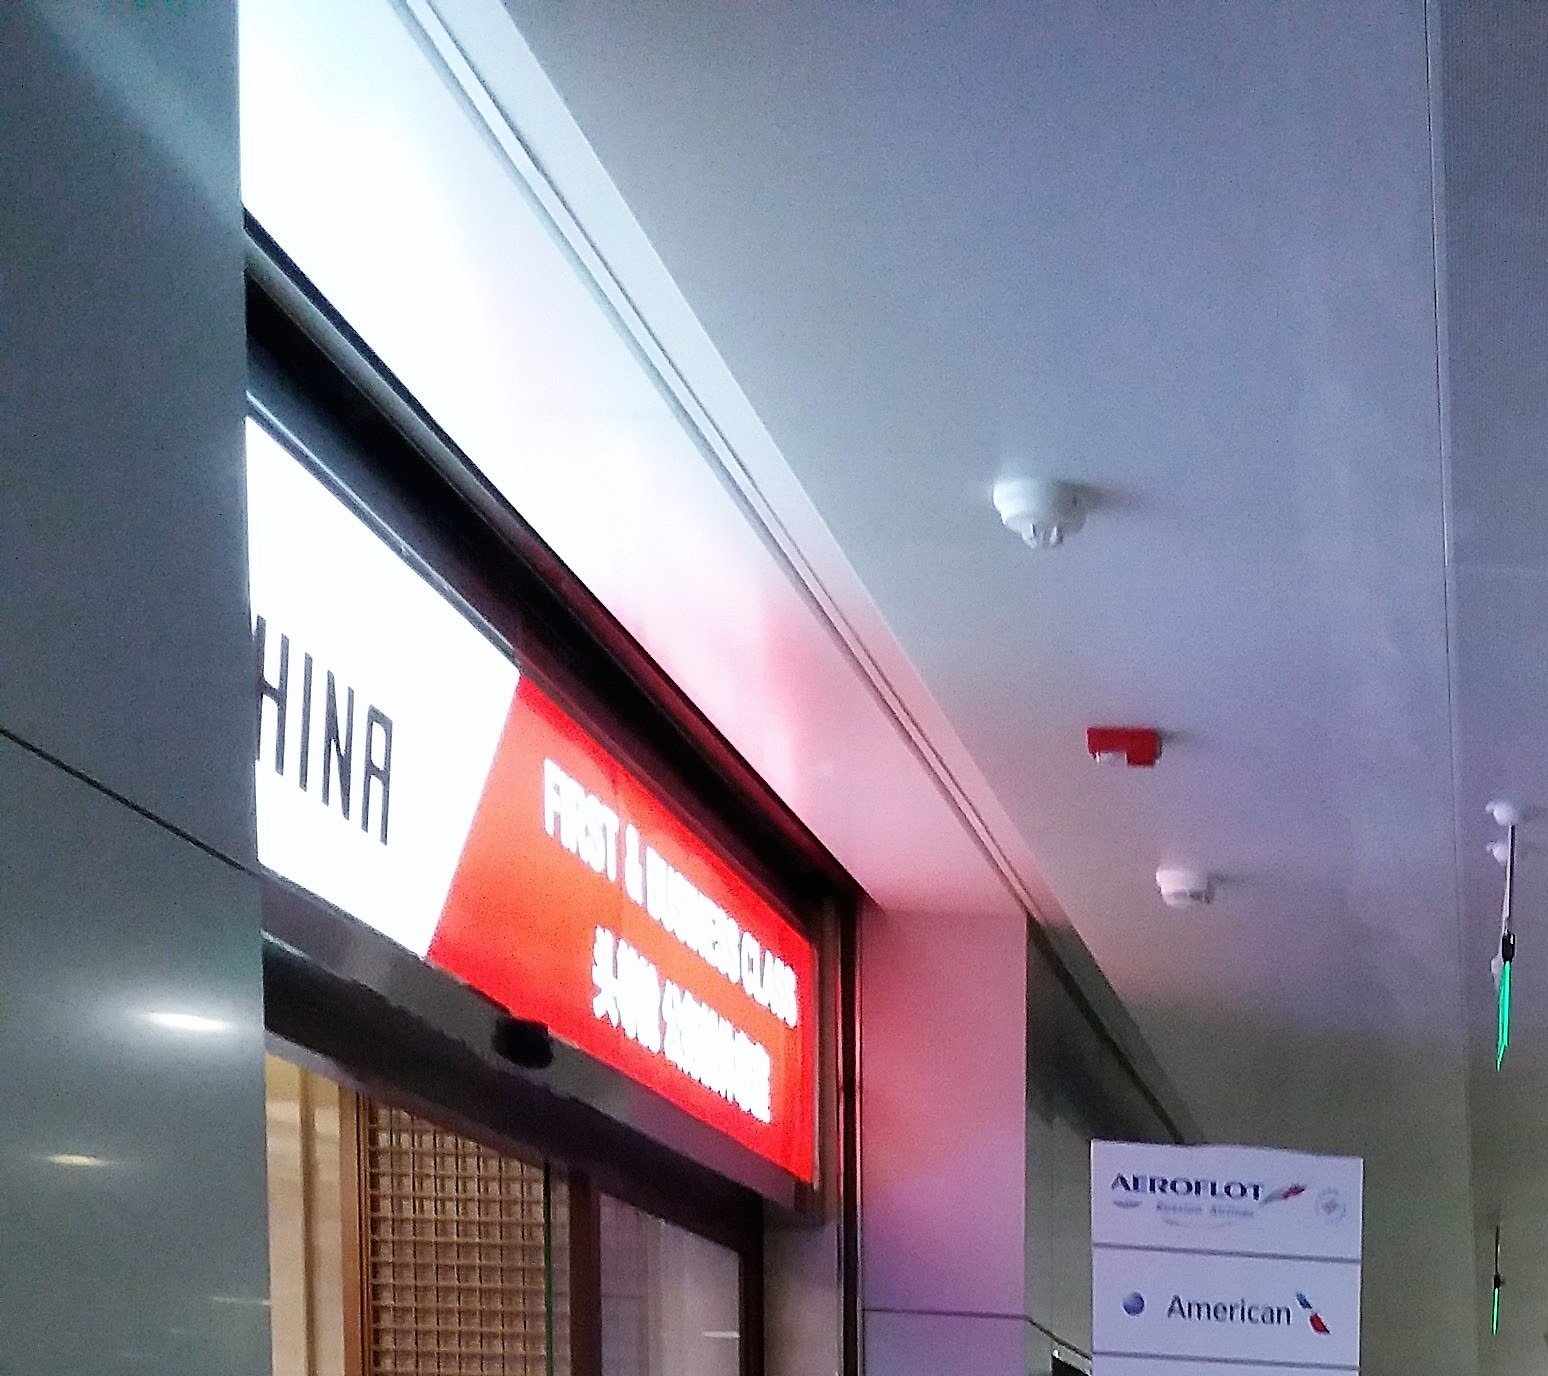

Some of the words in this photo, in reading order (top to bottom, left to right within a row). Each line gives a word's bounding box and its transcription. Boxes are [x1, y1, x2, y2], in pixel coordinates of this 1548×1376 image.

[544, 757, 620, 883] FIRST
[740, 930, 799, 1028] CLASS
[1111, 1172, 1264, 1201] AEROFLOT
[1167, 1294, 1292, 1326] American
